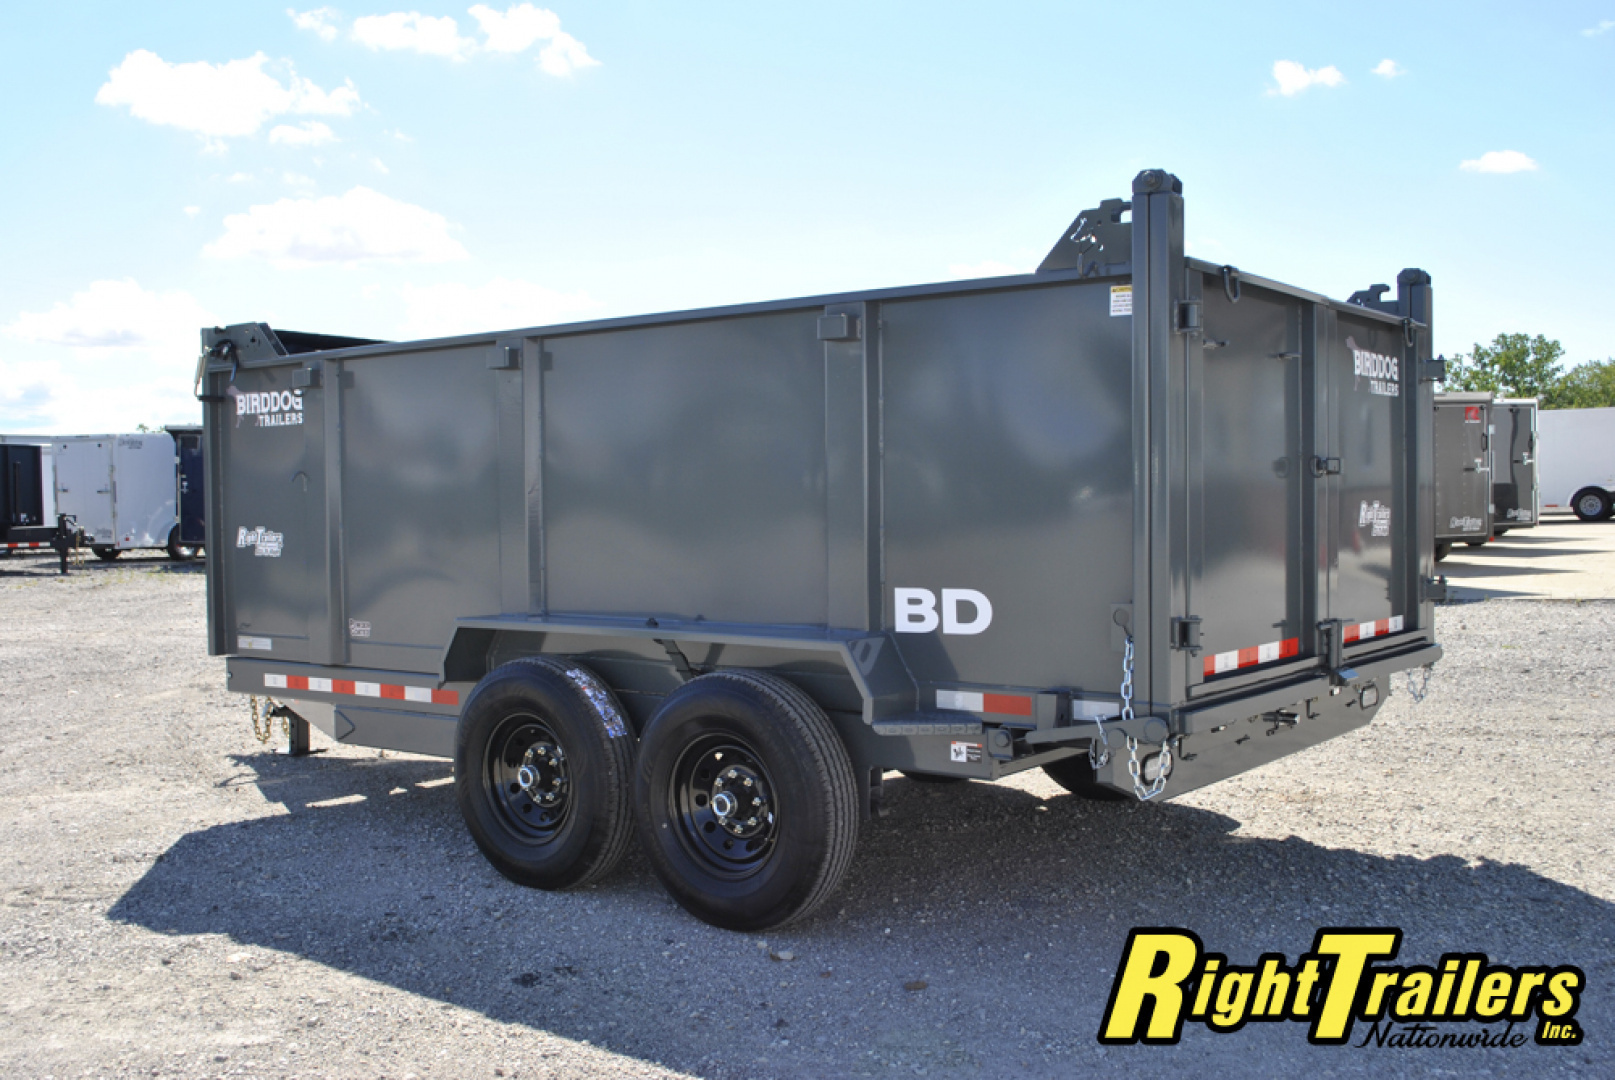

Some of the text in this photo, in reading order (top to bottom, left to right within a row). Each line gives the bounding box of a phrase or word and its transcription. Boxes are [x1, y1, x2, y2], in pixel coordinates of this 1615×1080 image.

[1353, 349, 1399, 381] BIRDDOG
[235, 388, 303, 415] BIRDDOG
[1370, 380, 1399, 397] TRAILERS
[258, 412, 303, 427] TRAILERS
[894, 587, 993, 635] BD
